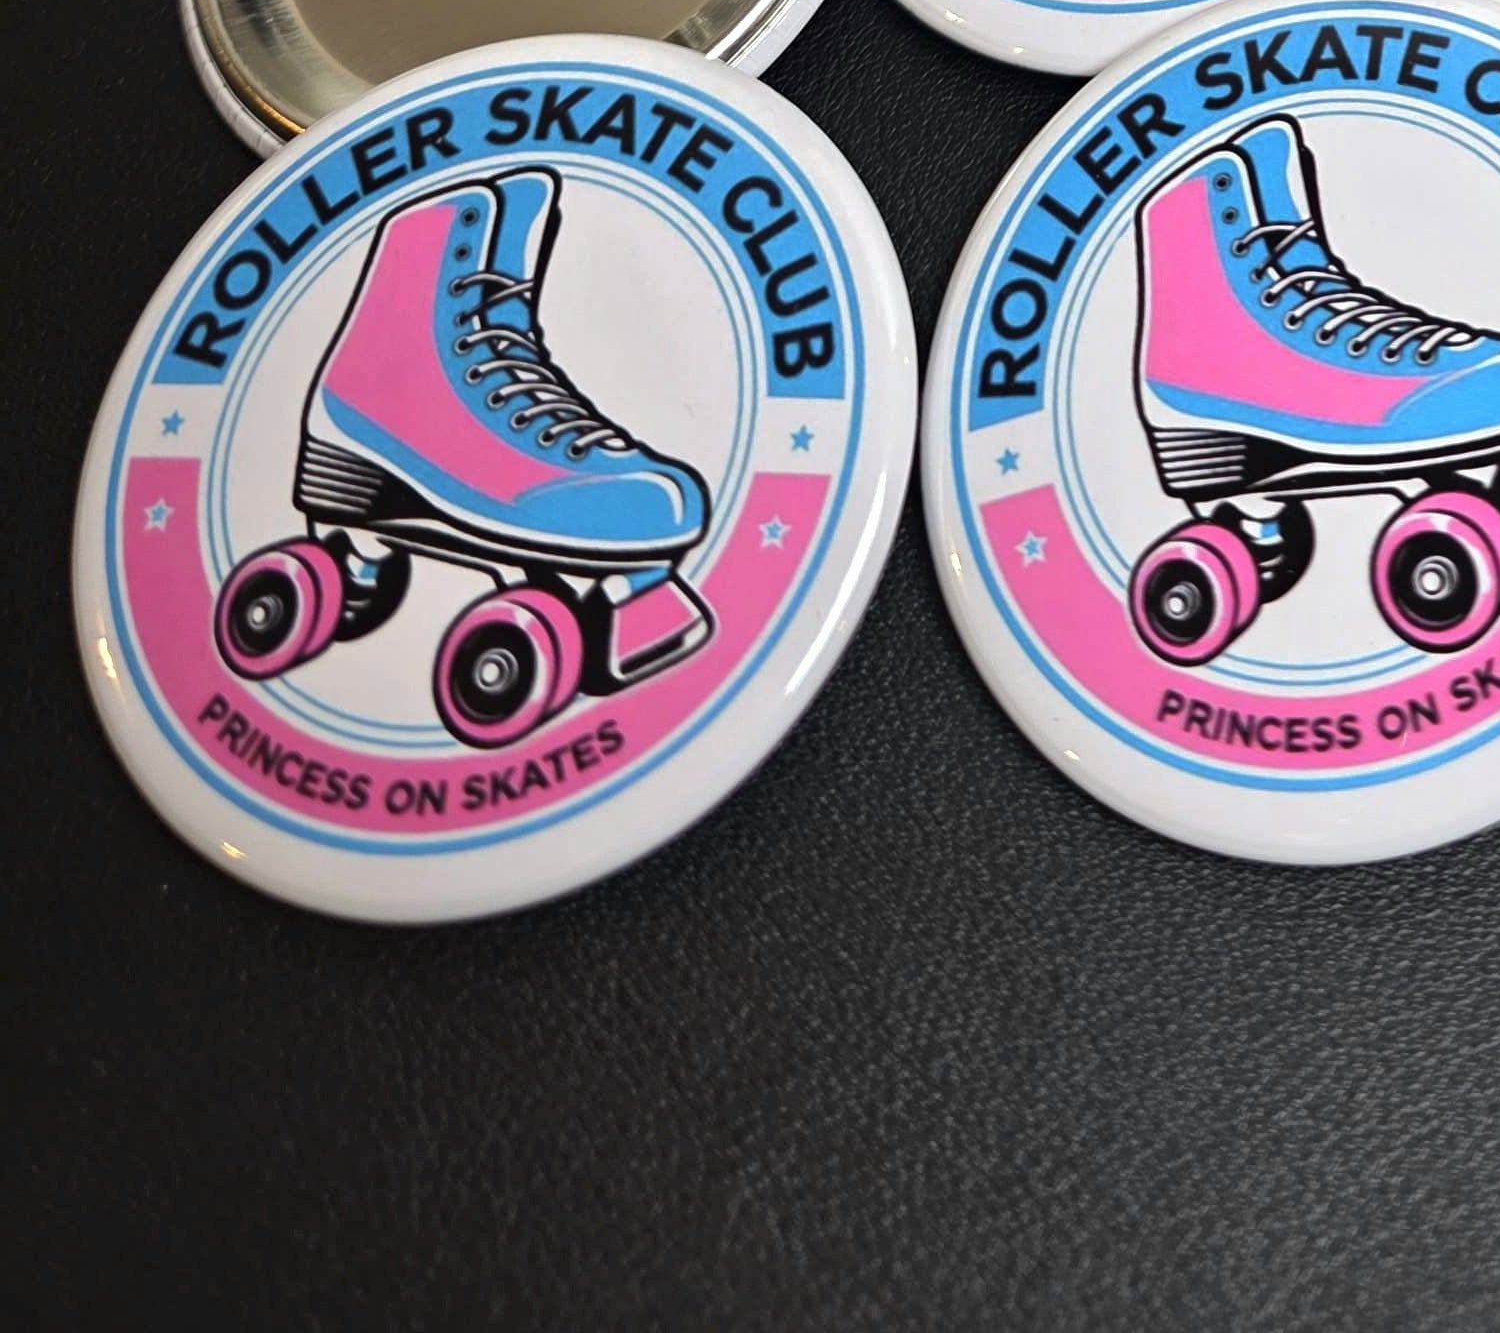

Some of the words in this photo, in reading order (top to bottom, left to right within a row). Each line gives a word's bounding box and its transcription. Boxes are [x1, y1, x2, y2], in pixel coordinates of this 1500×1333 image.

[176, 108, 461, 370] ROLLER
[482, 85, 735, 194] SKATE
[718, 175, 836, 380] CLUB
[976, 93, 1187, 401] ROLLER
[1196, 24, 1452, 111] SKATE
[197, 693, 374, 813] PRINCESS
[384, 776, 450, 817] ON
[460, 717, 627, 815] SKATES
[1156, 689, 1365, 756] PRINCESS
[1376, 700, 1442, 742] ON
